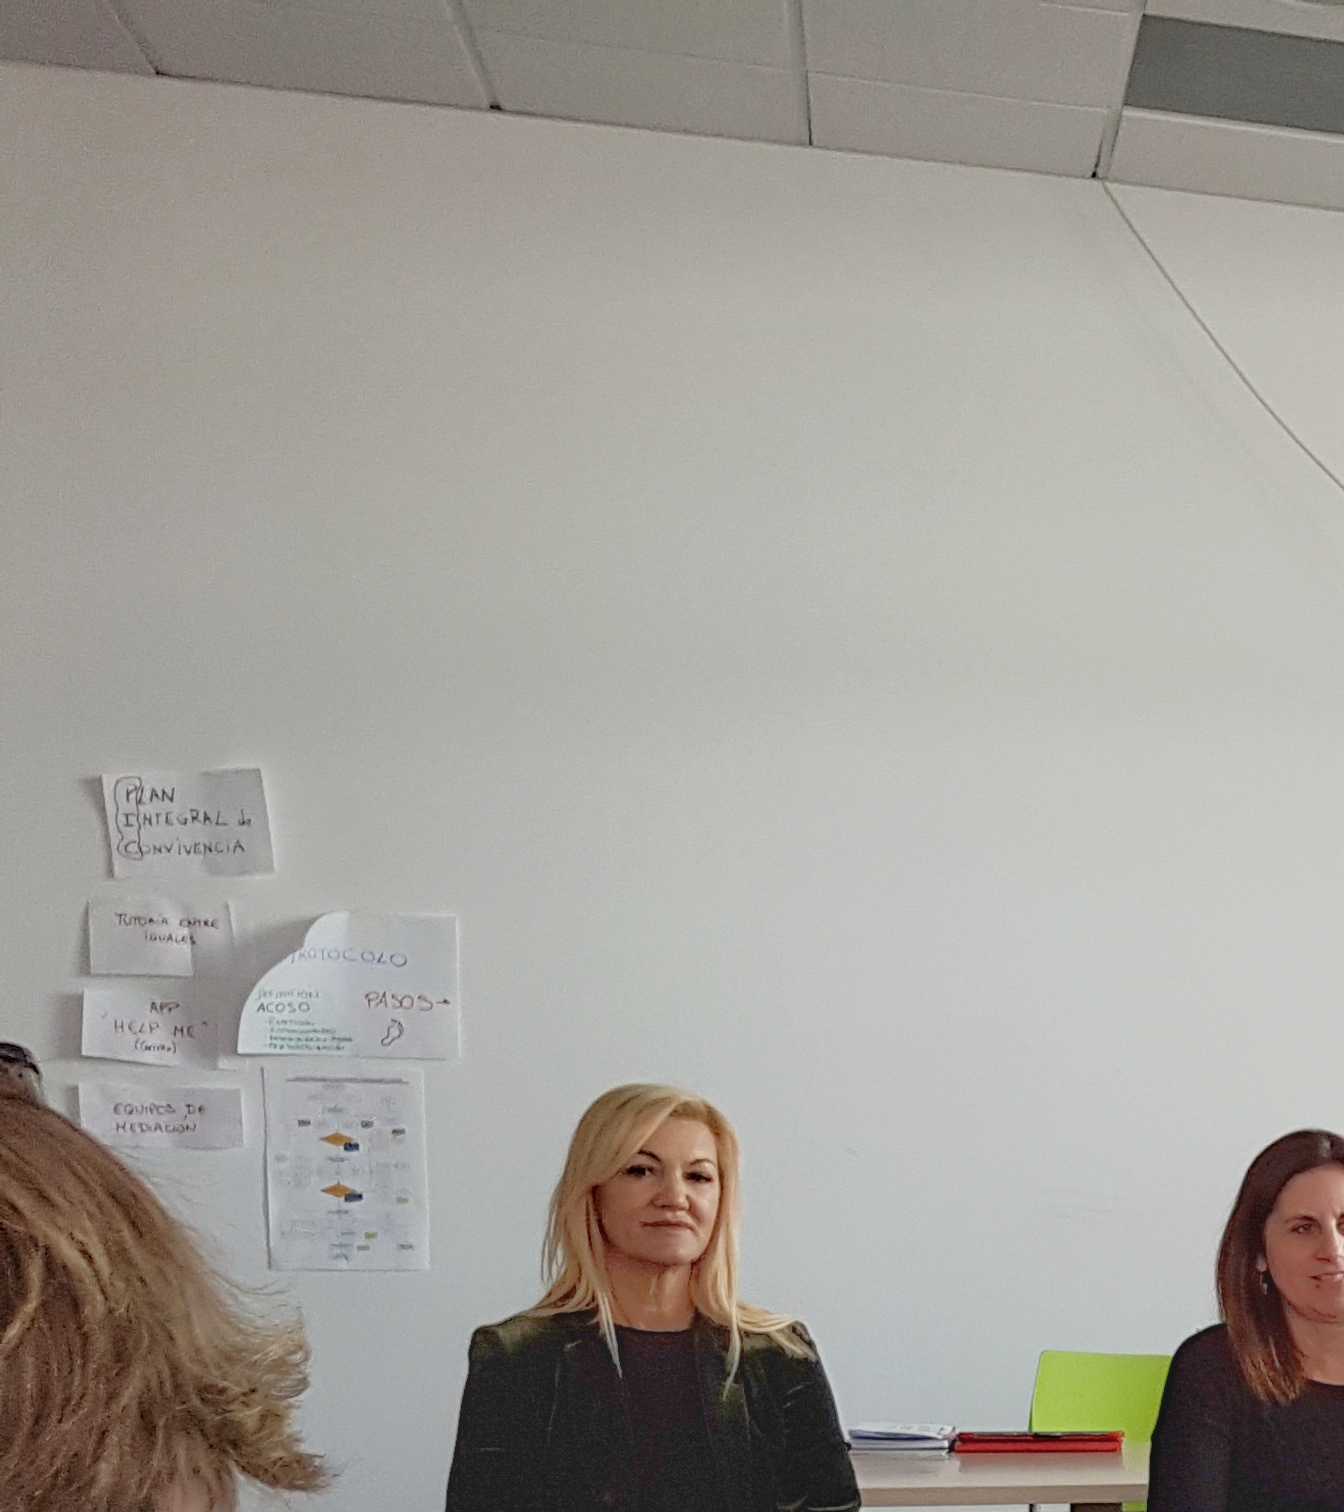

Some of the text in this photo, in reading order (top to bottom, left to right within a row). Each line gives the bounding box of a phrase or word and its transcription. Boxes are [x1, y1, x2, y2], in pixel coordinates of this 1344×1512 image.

[126, 784, 175, 805] PLAN
[123, 809, 228, 827] INTEGRAL
[124, 837, 246, 856] CONVIVENCIA
[256, 1001, 311, 1014] ACOSO
[365, 990, 434, 1011] PASOS
[113, 1103, 176, 1115] EQUIPOS
